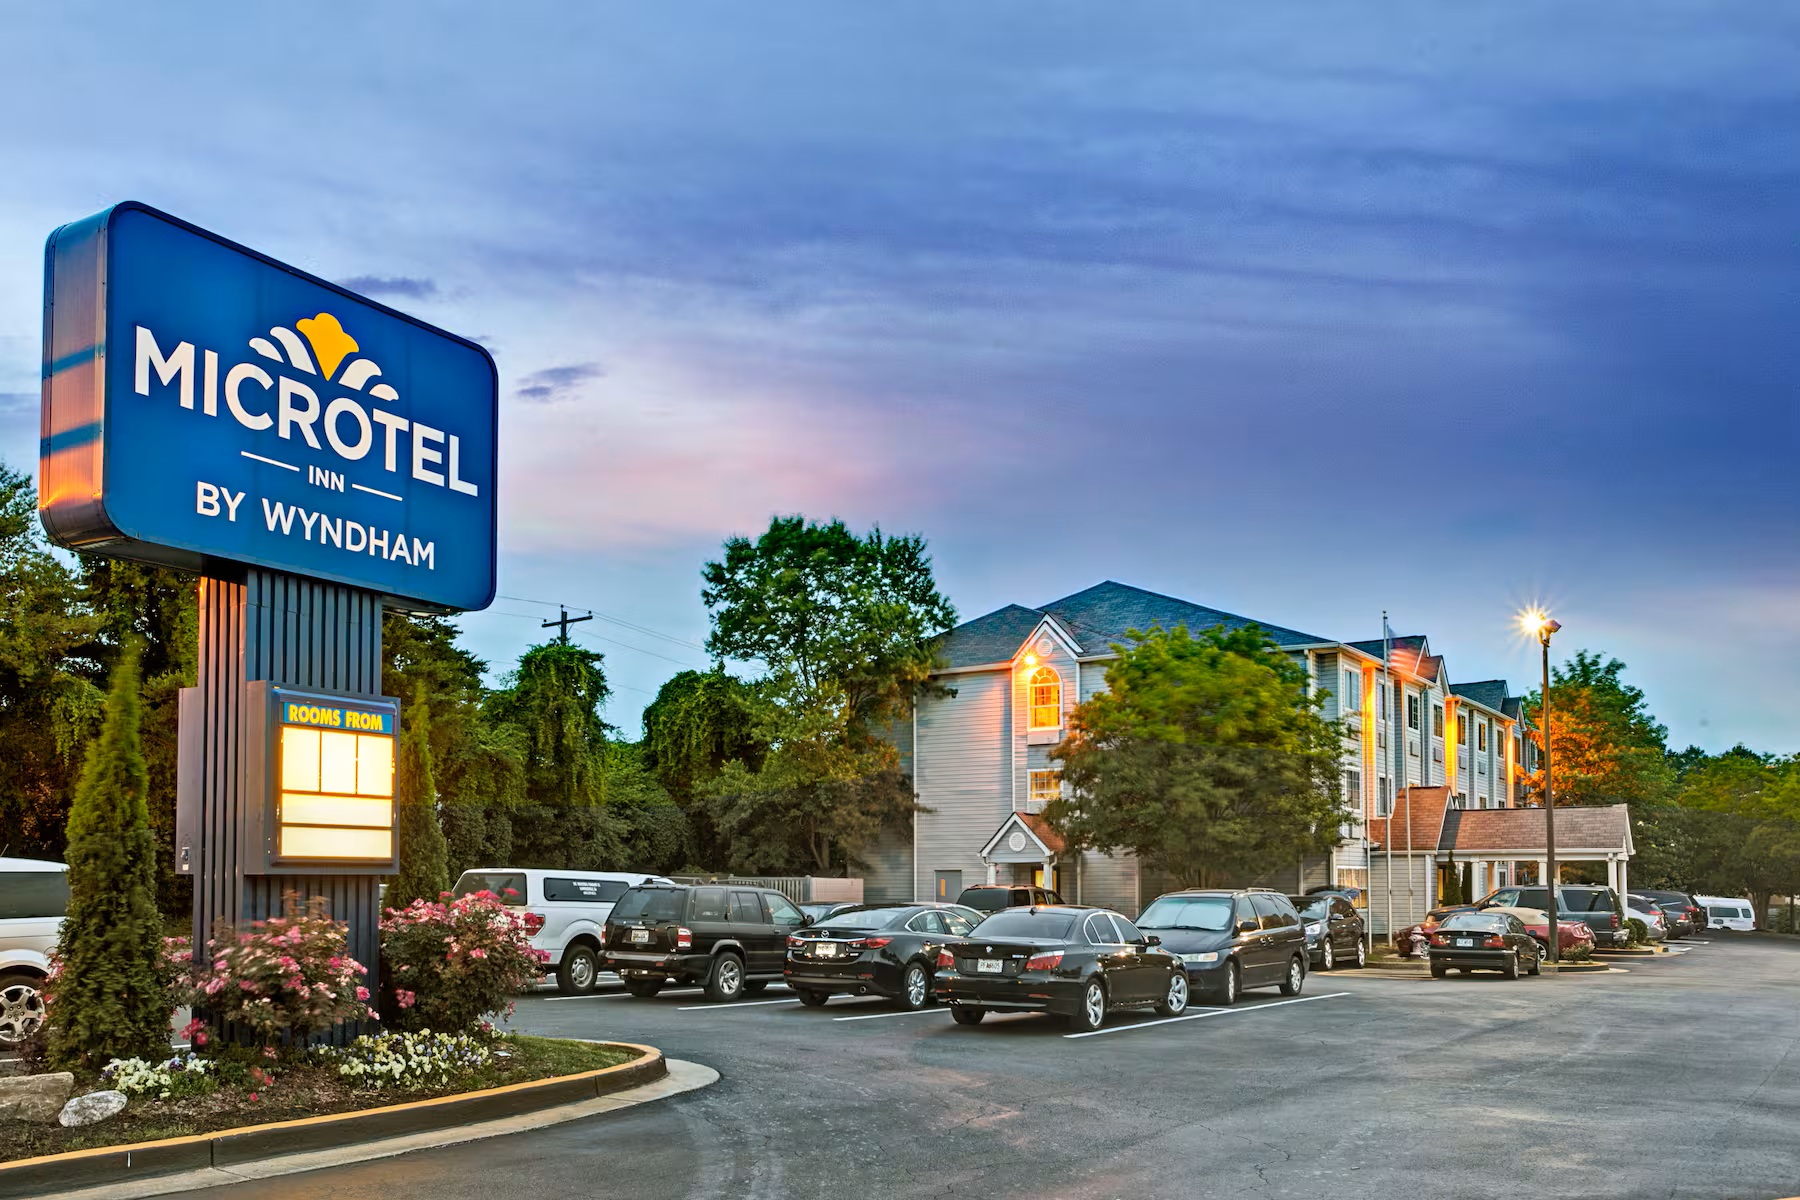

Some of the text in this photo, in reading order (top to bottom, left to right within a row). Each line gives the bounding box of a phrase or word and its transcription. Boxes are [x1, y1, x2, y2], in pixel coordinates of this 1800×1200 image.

[135, 325, 478, 497] MICROTEL
[309, 465, 345, 493] INN
[196, 482, 435, 570] BY WYNDHAM
[288, 704, 383, 730] ROOMS FROM
